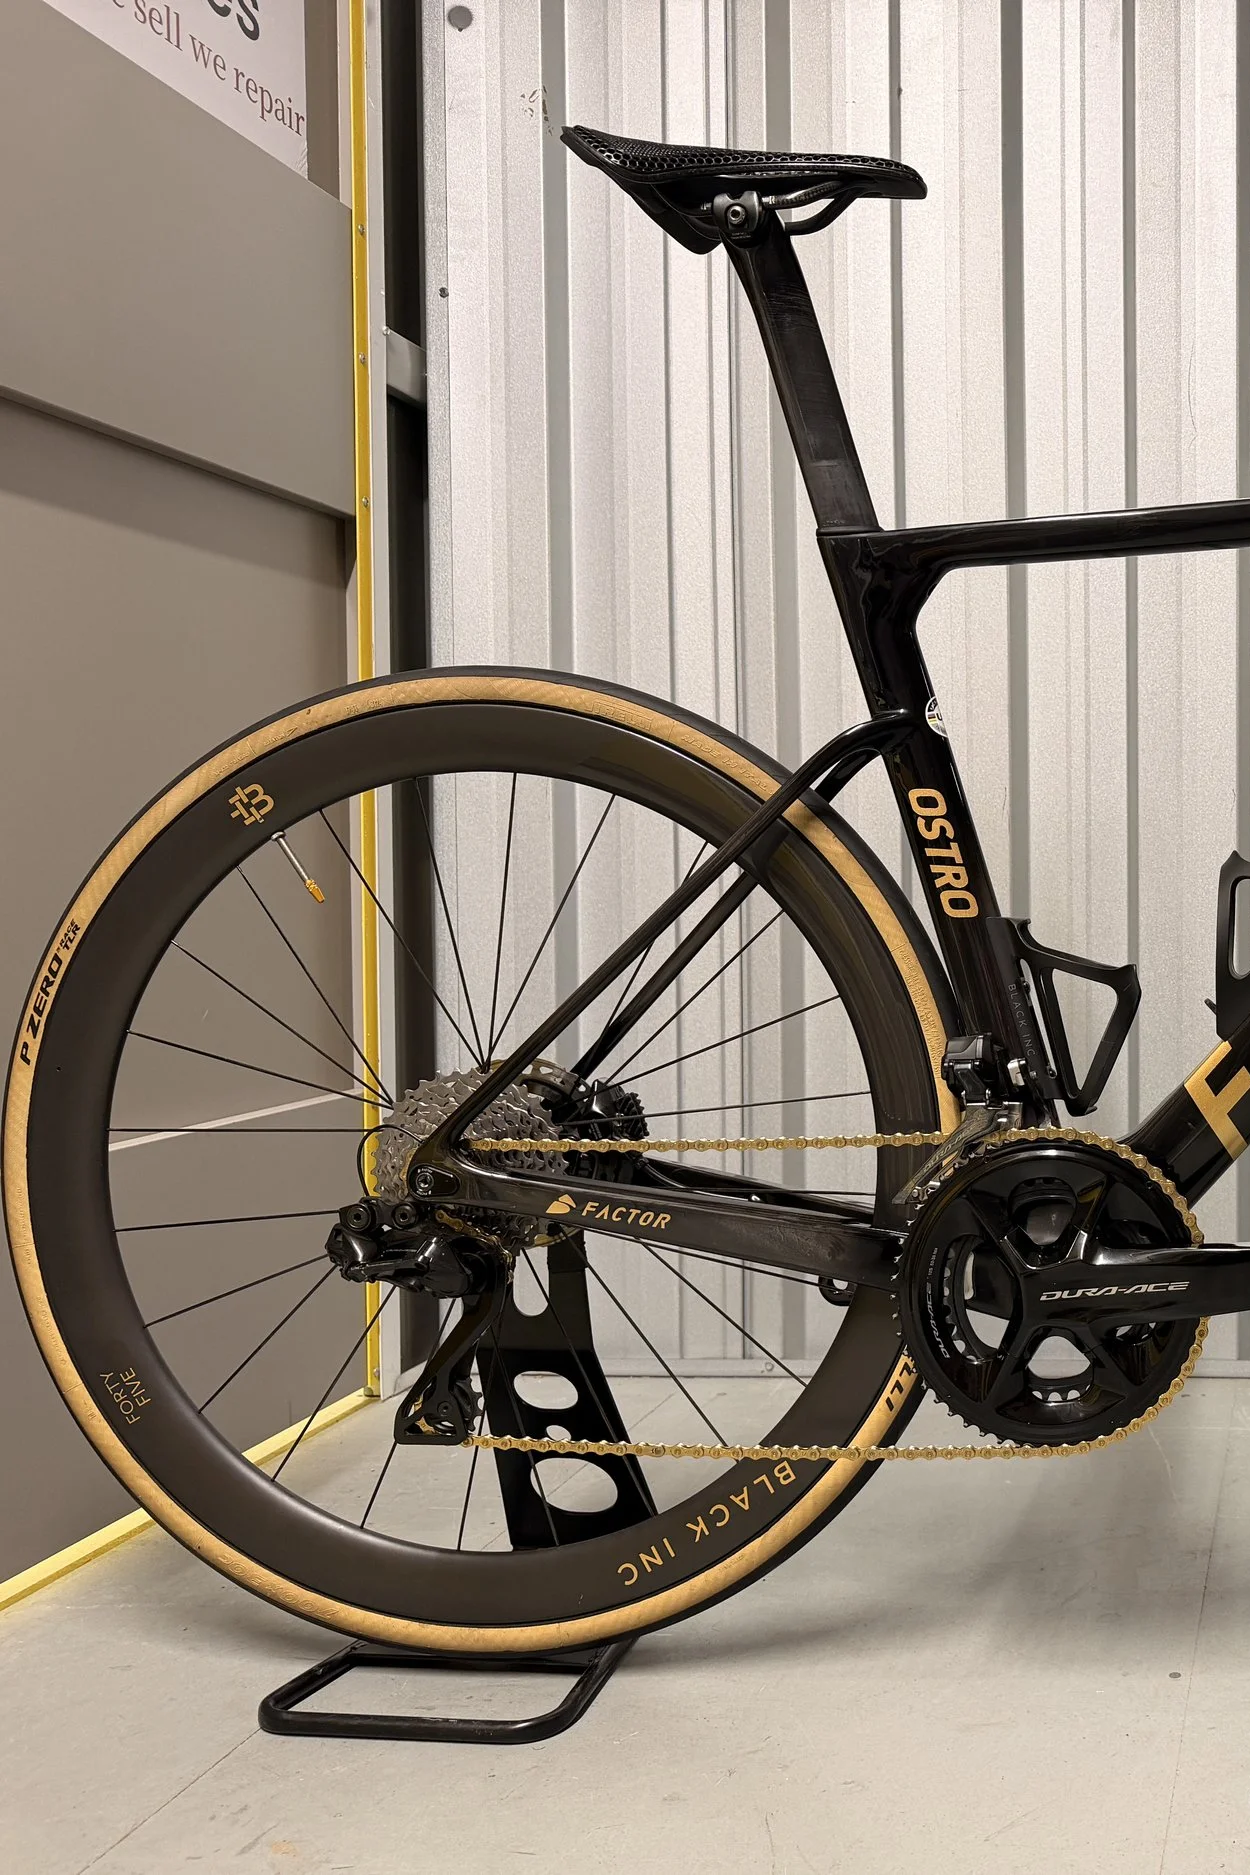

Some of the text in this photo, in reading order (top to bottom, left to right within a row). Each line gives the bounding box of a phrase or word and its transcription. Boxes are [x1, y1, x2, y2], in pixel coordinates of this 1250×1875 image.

[134, 0, 305, 137] sell we repair
[908, 788, 979, 918] OSTRO
[60, 919, 81, 950] RACE TLR
[20, 953, 62, 1065] P ZERO
[1008, 983, 1036, 1056] BLACK INC
[581, 1202, 672, 1229] FACTOR
[1040, 1281, 1190, 1301] DURA-ACE
[100, 1371, 141, 1425] FORTY
[120, 1367, 151, 1407] FIVE
[617, 1461, 796, 1586] BLACK INC
